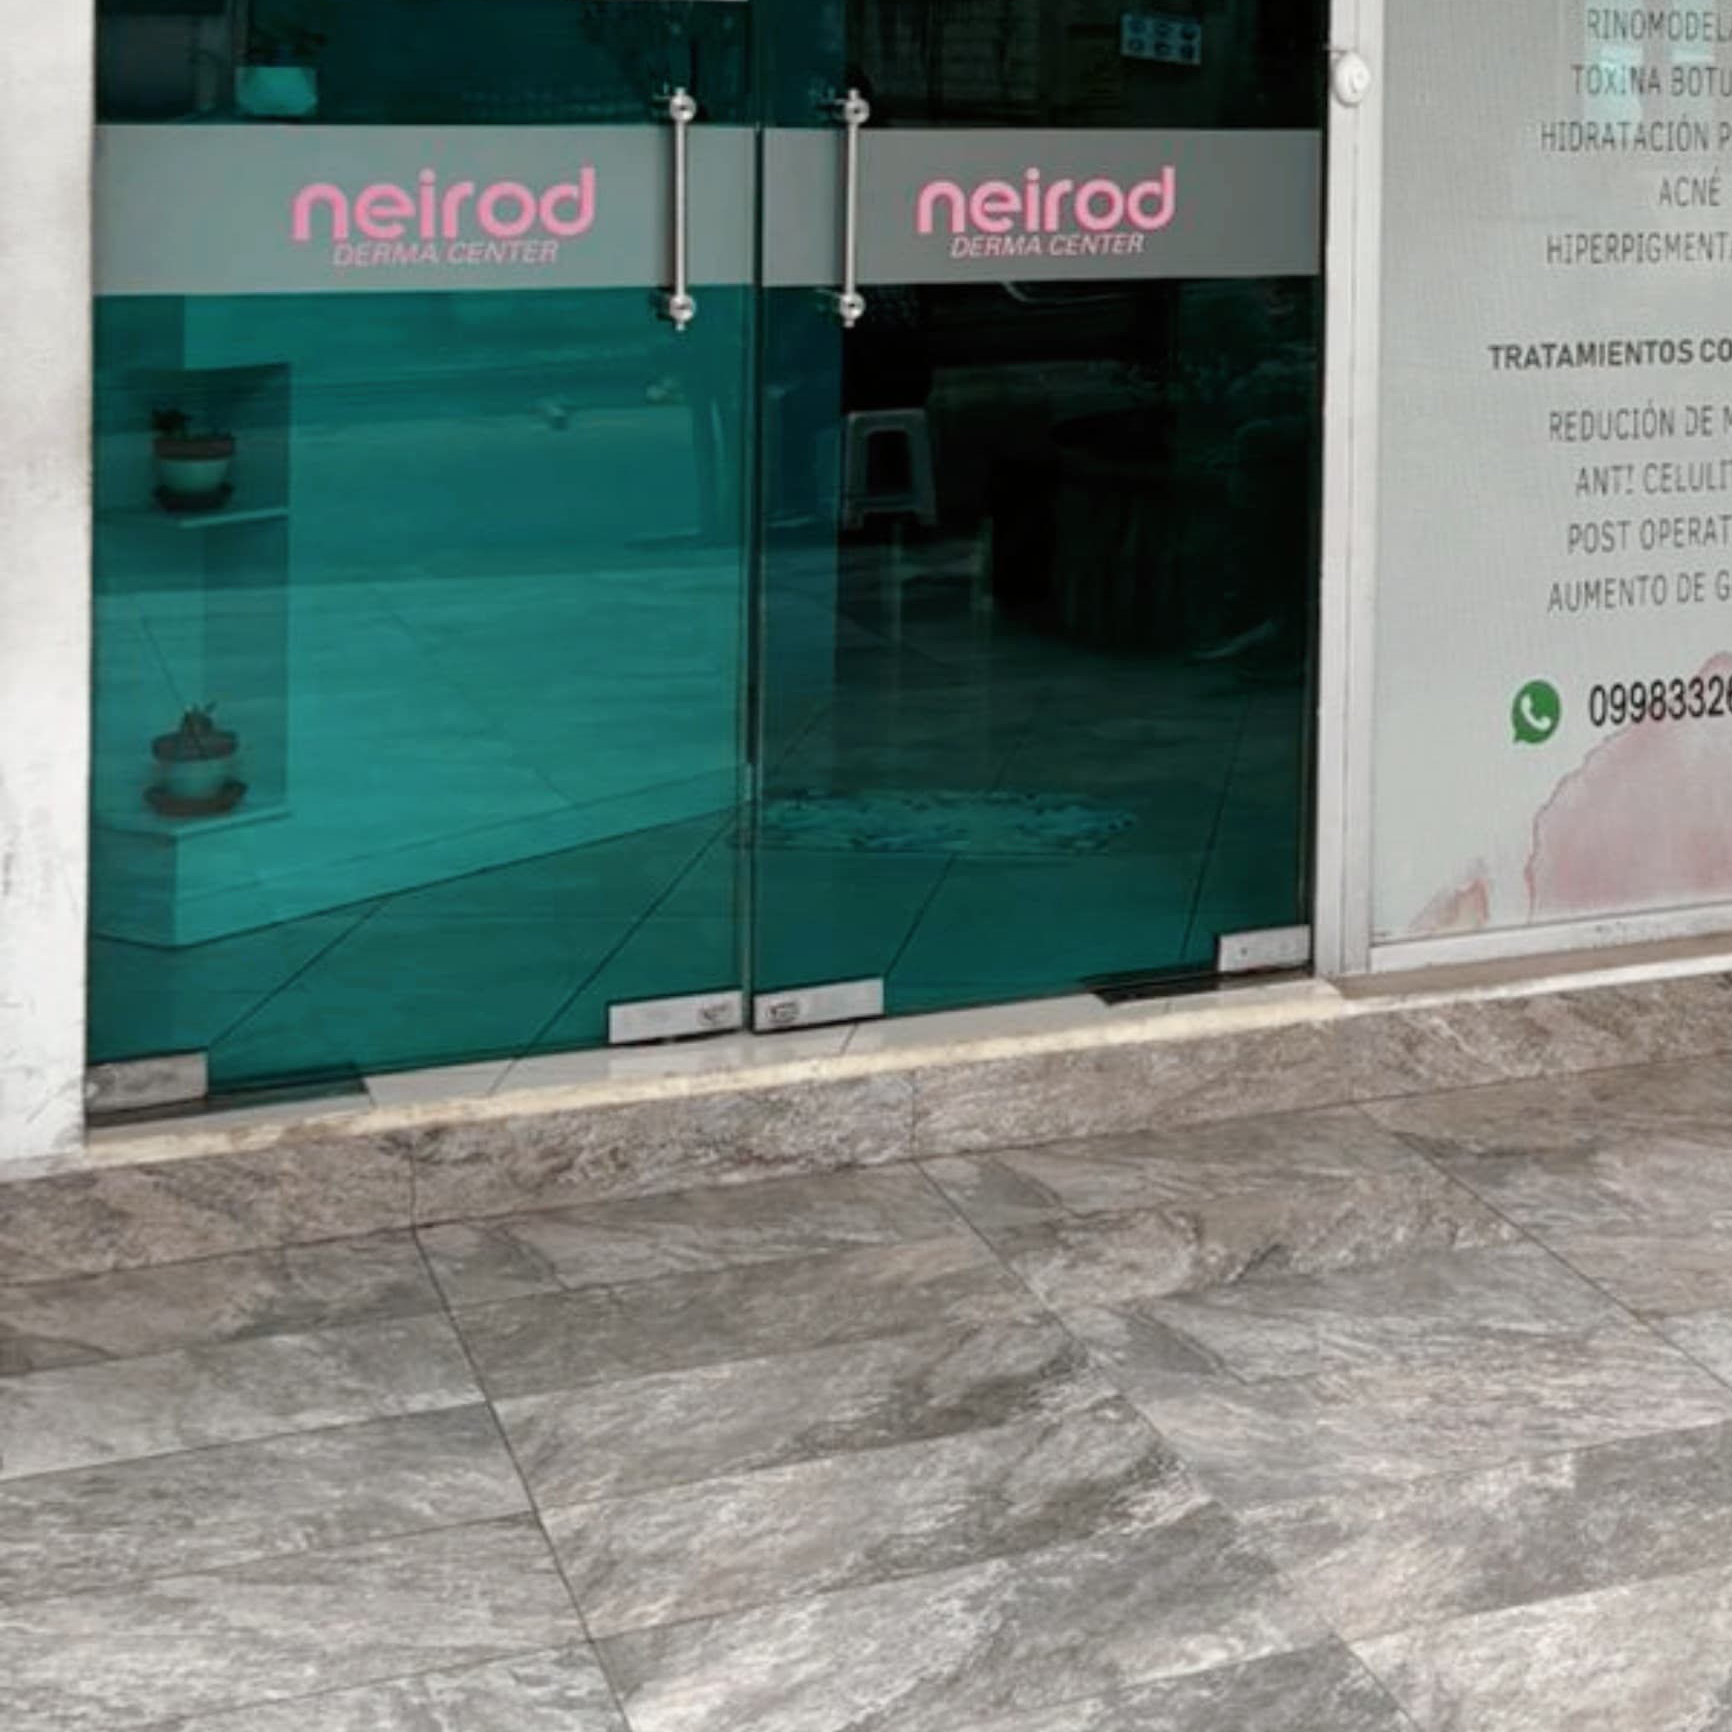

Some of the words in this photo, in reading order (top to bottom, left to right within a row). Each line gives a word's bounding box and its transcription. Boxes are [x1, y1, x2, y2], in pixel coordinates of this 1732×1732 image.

[1571, 63, 1661, 97] TOXINA
[1539, 113, 1709, 153] HIDRATACIÓN
[289, 166, 596, 243] neirod
[915, 165, 1177, 235] neirod
[1658, 168, 1722, 207] ACNÉ
[332, 238, 439, 268] DERMA
[446, 238, 560, 265] CENTER
[950, 233, 1042, 259] DERMA
[1048, 232, 1146, 257] CENTER
[1487, 337, 1695, 371] TRATAMIENTOS
[1548, 399, 1676, 443] REDUCIÓN
[1684, 404, 1715, 438] DE
[1575, 464, 1635, 497] ANTI
[1567, 520, 1632, 555] POST
[1547, 573, 1668, 613] AUMENTO
[1676, 570, 1707, 604] DE
